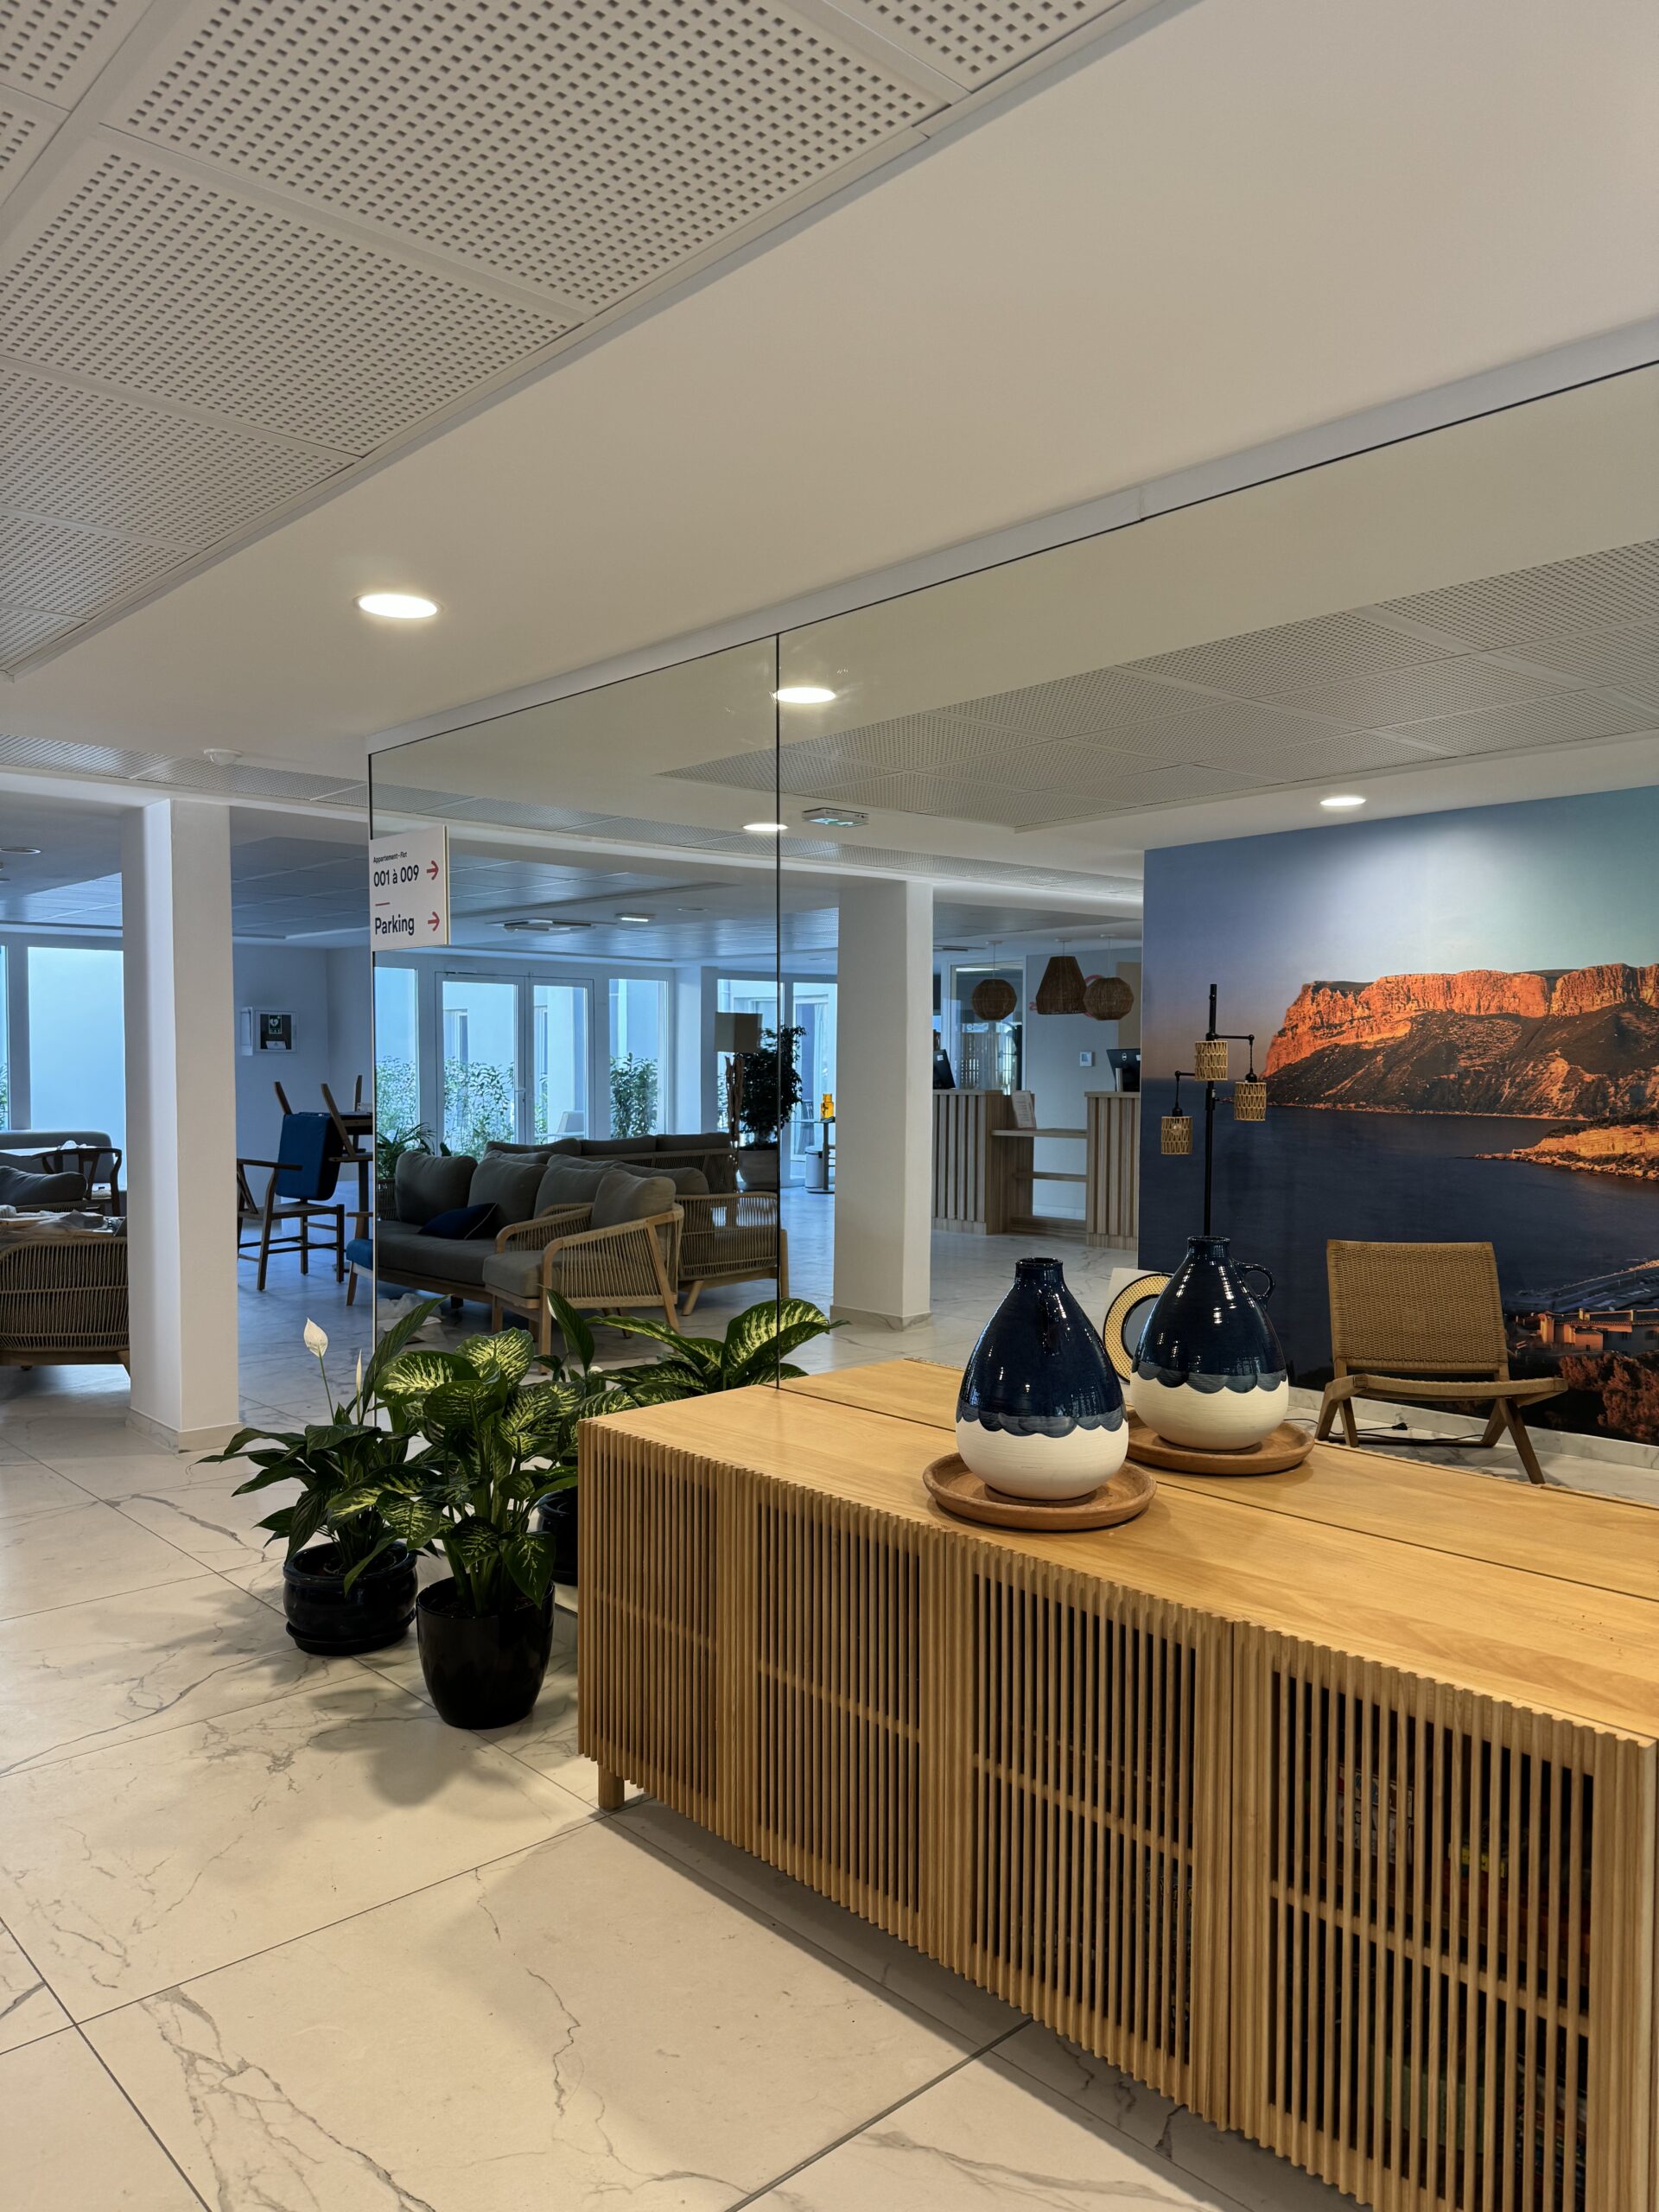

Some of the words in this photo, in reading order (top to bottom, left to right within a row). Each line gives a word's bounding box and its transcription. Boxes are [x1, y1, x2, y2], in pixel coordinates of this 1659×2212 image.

[373, 870, 390, 887] 001
[392, 868, 398, 884] à
[400, 864, 419, 882] 009
[375, 913, 415, 936] Parking
